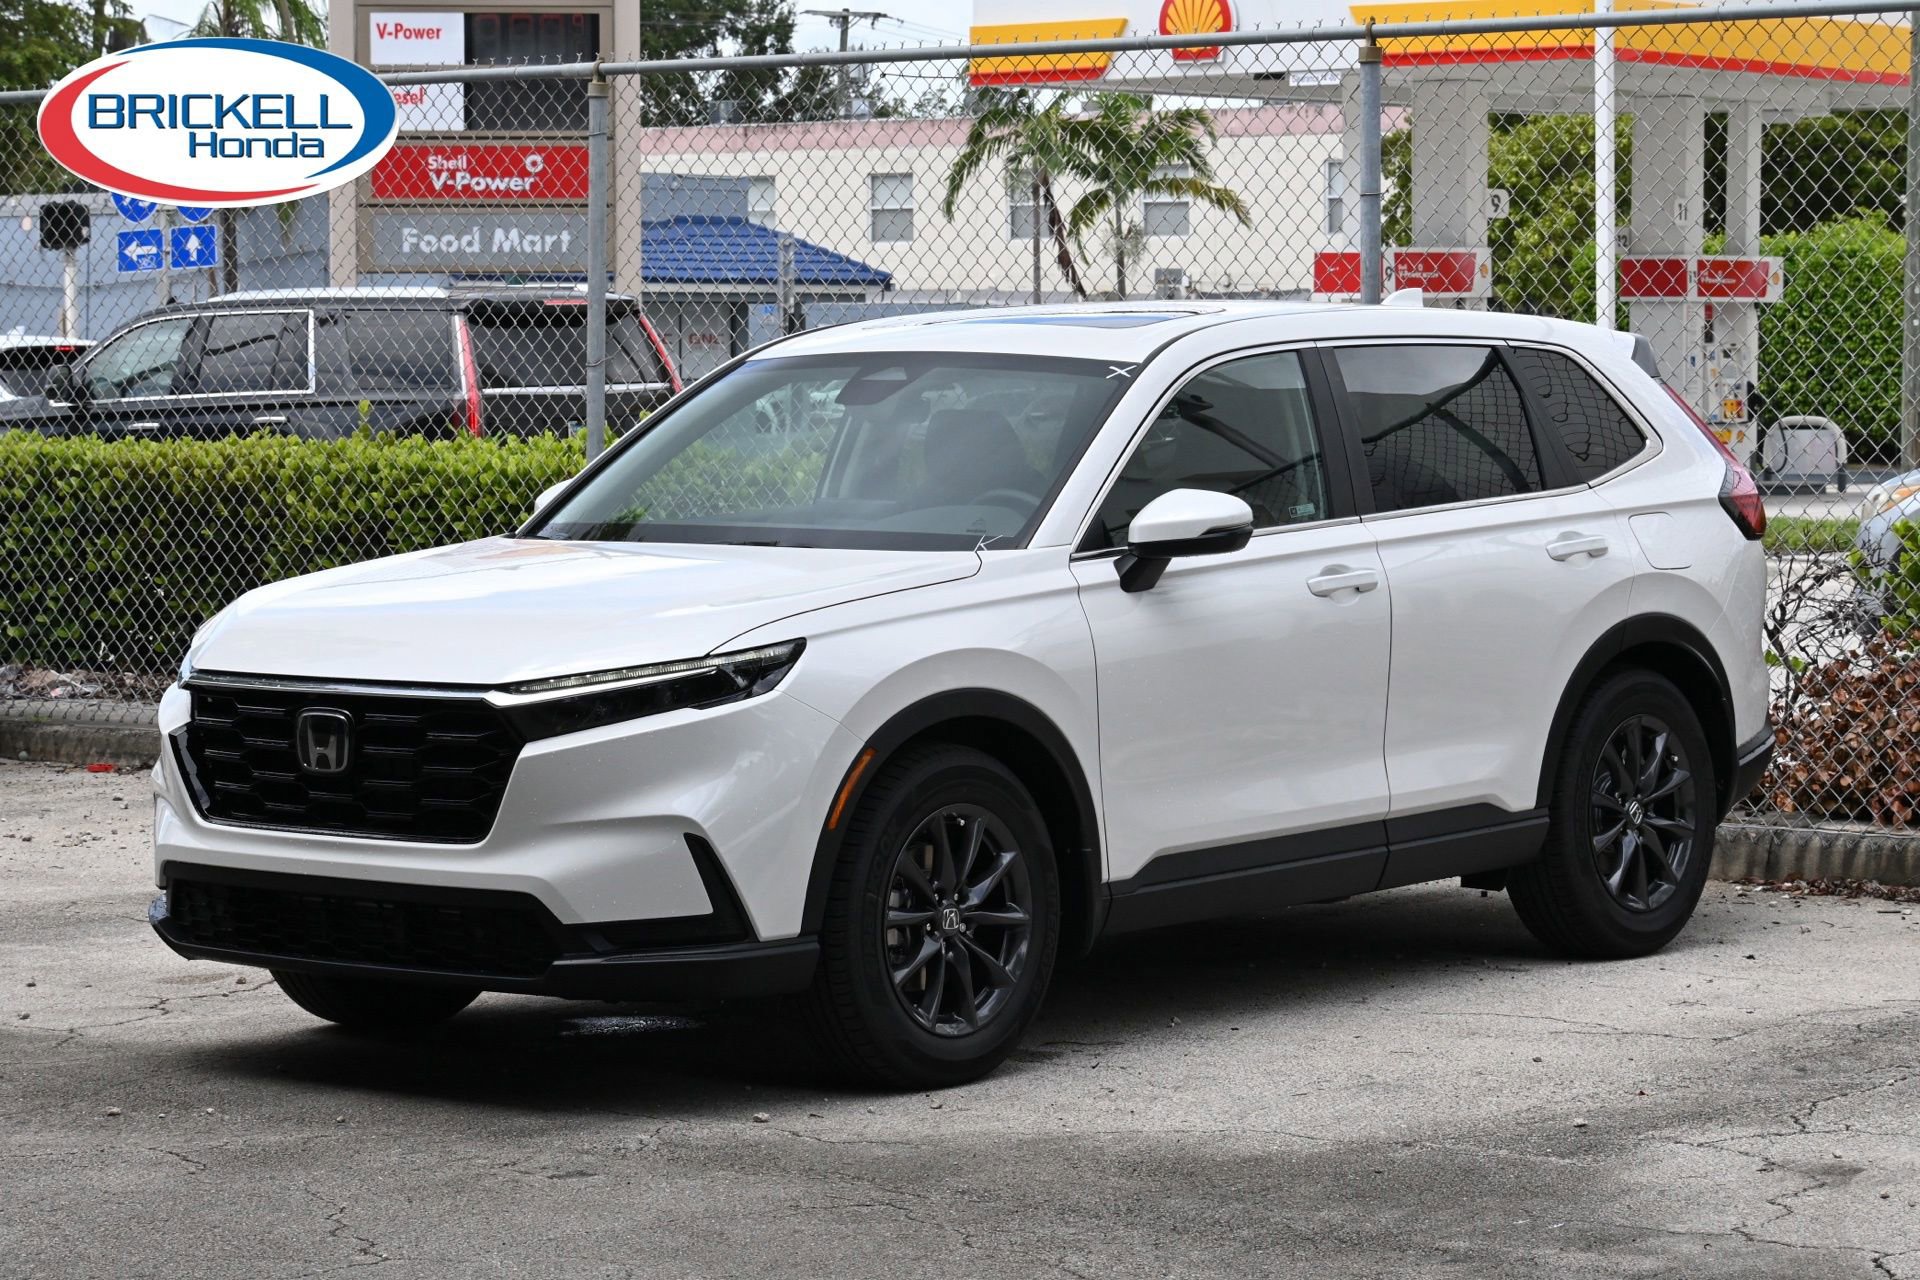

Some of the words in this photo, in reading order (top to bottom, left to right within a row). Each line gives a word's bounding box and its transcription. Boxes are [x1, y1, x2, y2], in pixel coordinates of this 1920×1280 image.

[376, 22, 442, 40] V-Power
[393, 87, 423, 104] esel
[427, 155, 467, 170] Shell
[429, 171, 535, 191] V-Power
[1490, 193, 1501, 212] 9
[402, 226, 480, 253] Food
[492, 227, 571, 253] Mart
